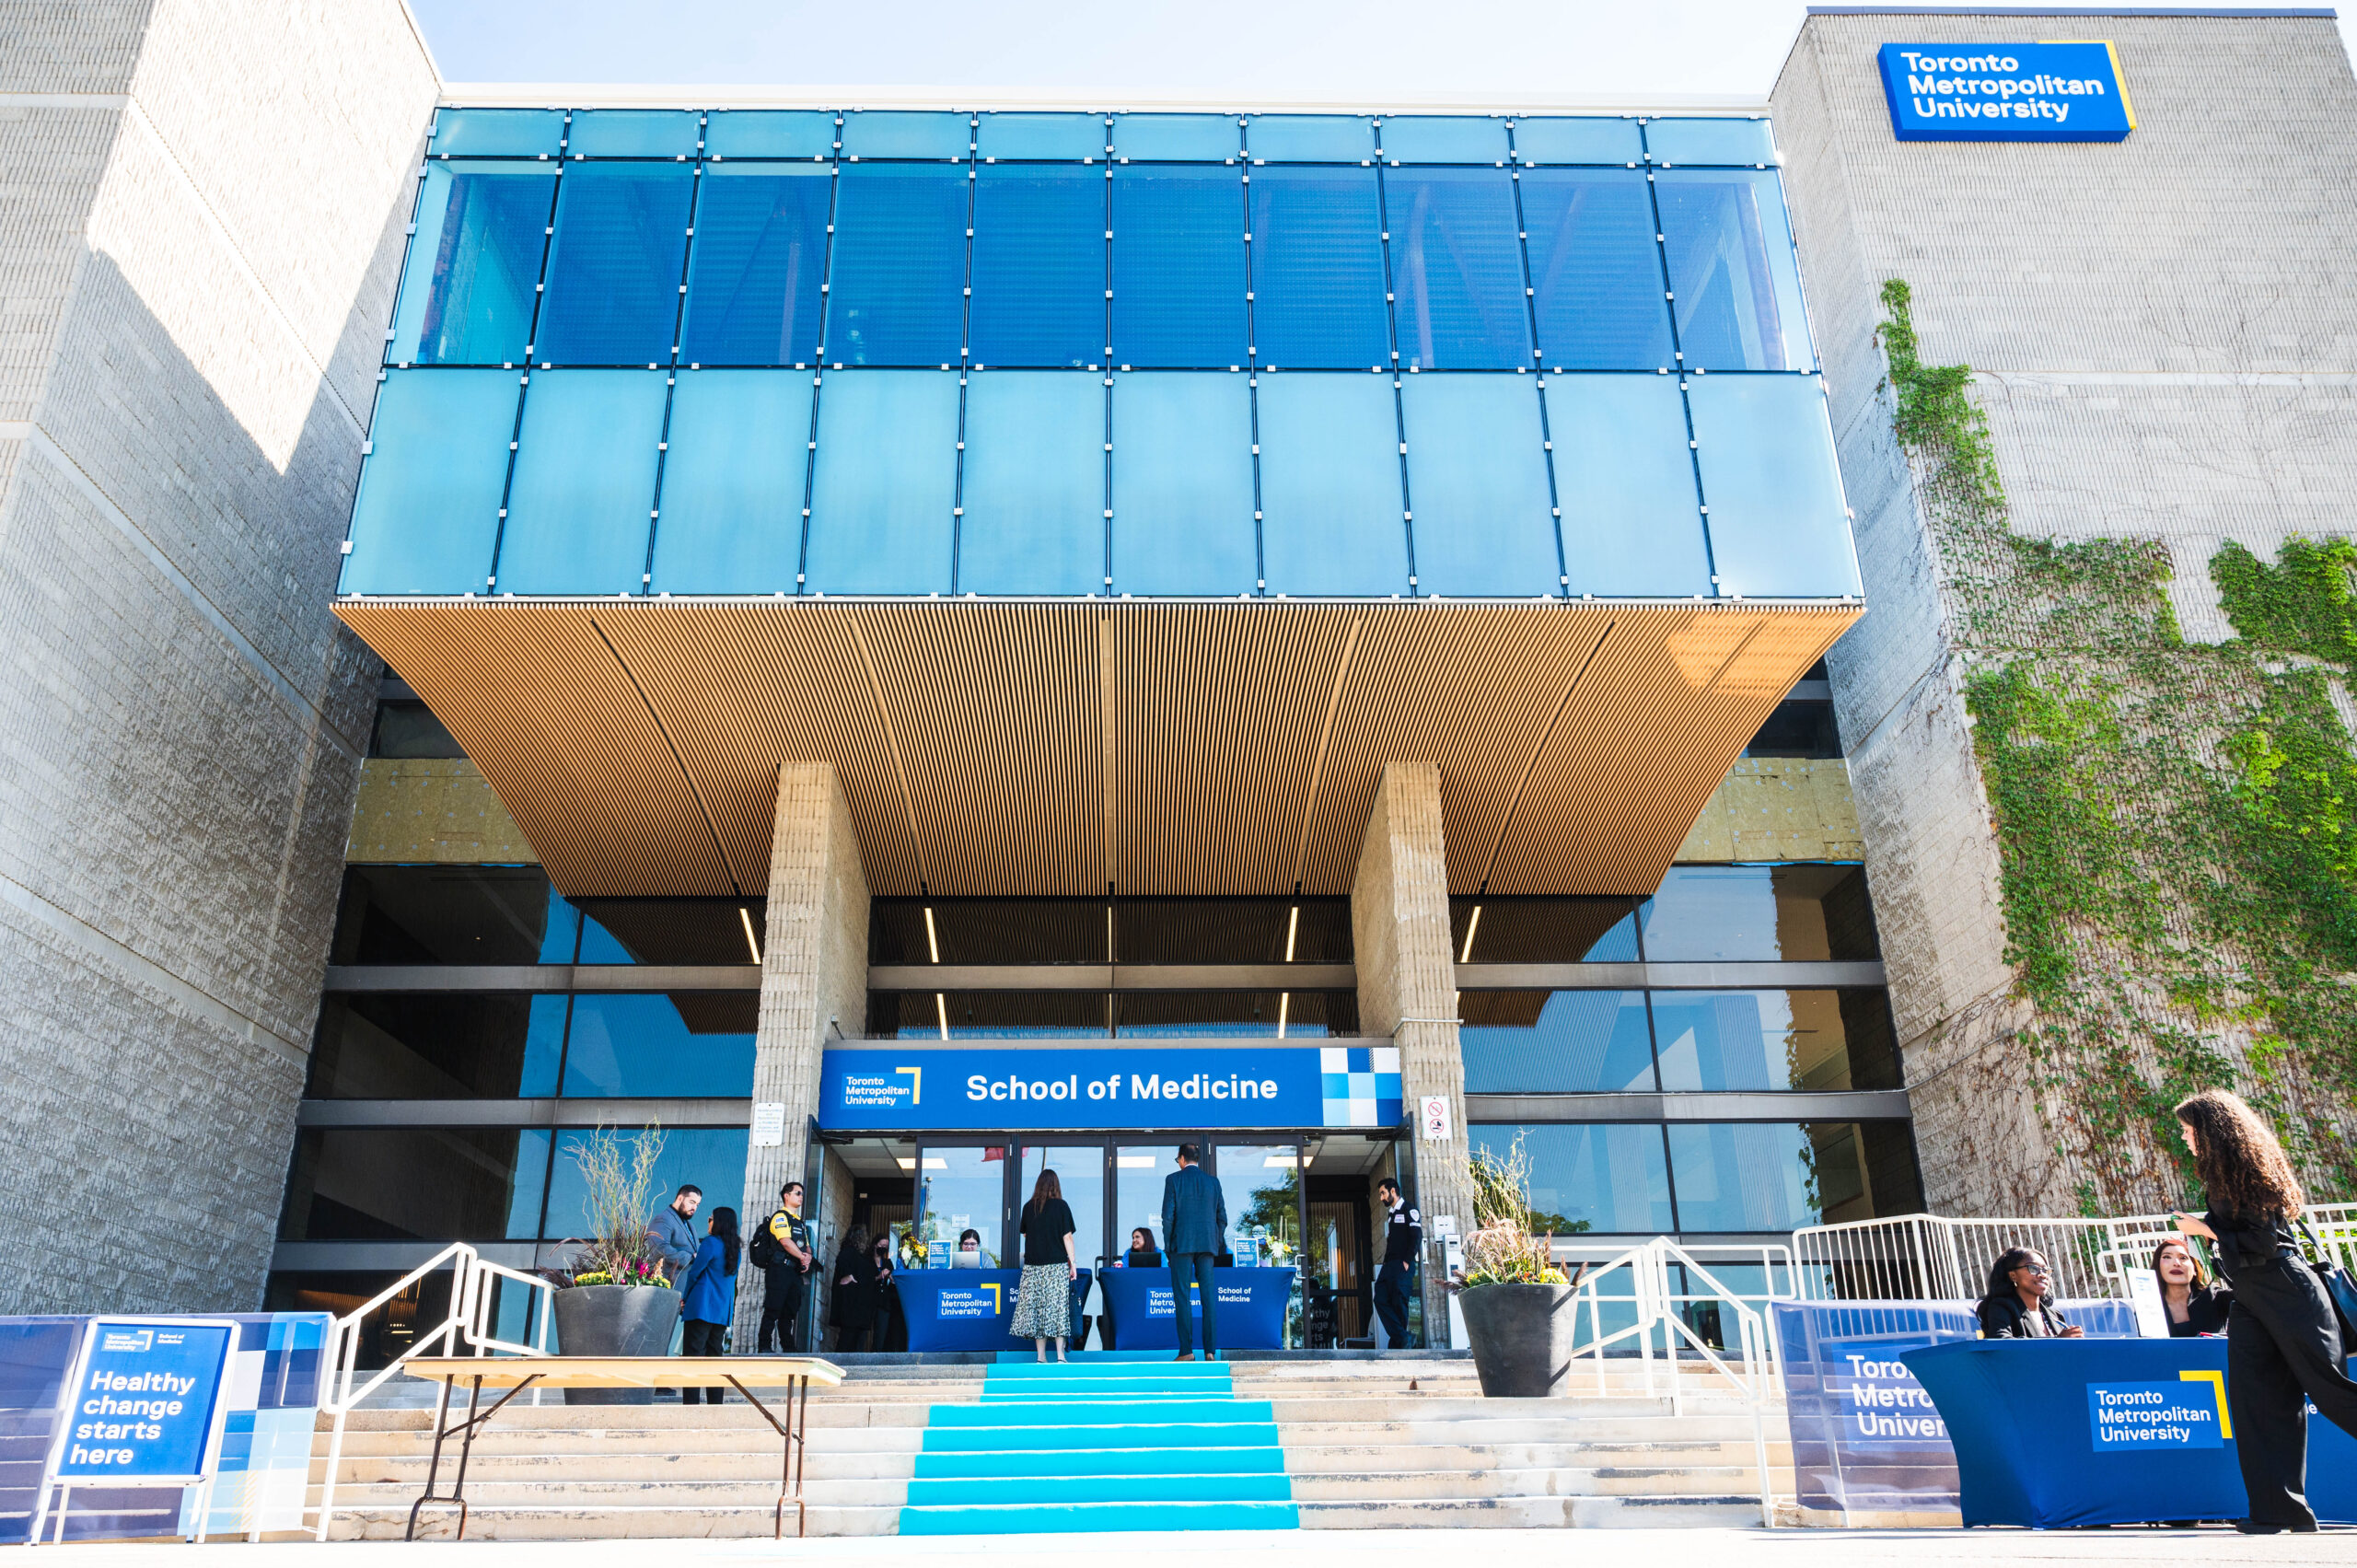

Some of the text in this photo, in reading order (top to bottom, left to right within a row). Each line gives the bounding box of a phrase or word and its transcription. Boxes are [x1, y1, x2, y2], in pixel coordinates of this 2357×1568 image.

[1900, 52, 2019, 72] Toronto
[1908, 75, 2105, 99] Metropolitan
[1913, 98, 2069, 122] University
[846, 1076, 885, 1086] Toronto
[967, 1074, 1278, 1100] School of Medicine
[845, 1086, 910, 1097] Metropolitan
[845, 1096, 897, 1107] University
[941, 1299, 993, 1308] Metropolitan
[1218, 1295, 1250, 1303] Medicine
[941, 1307, 981, 1317] University
[1149, 1307, 1176, 1315] Univer
[1845, 1354, 1916, 1379] Toro
[89, 1370, 196, 1396] Healthy
[2096, 1389, 2164, 1406] Toronto
[83, 1395, 183, 1421] change
[2098, 1406, 2212, 1426] Metropolitan
[75, 1421, 161, 1441] starts
[1857, 1411, 1945, 1437] Univer
[2100, 1424, 2190, 1443] University
[69, 1443, 134, 1465] here
